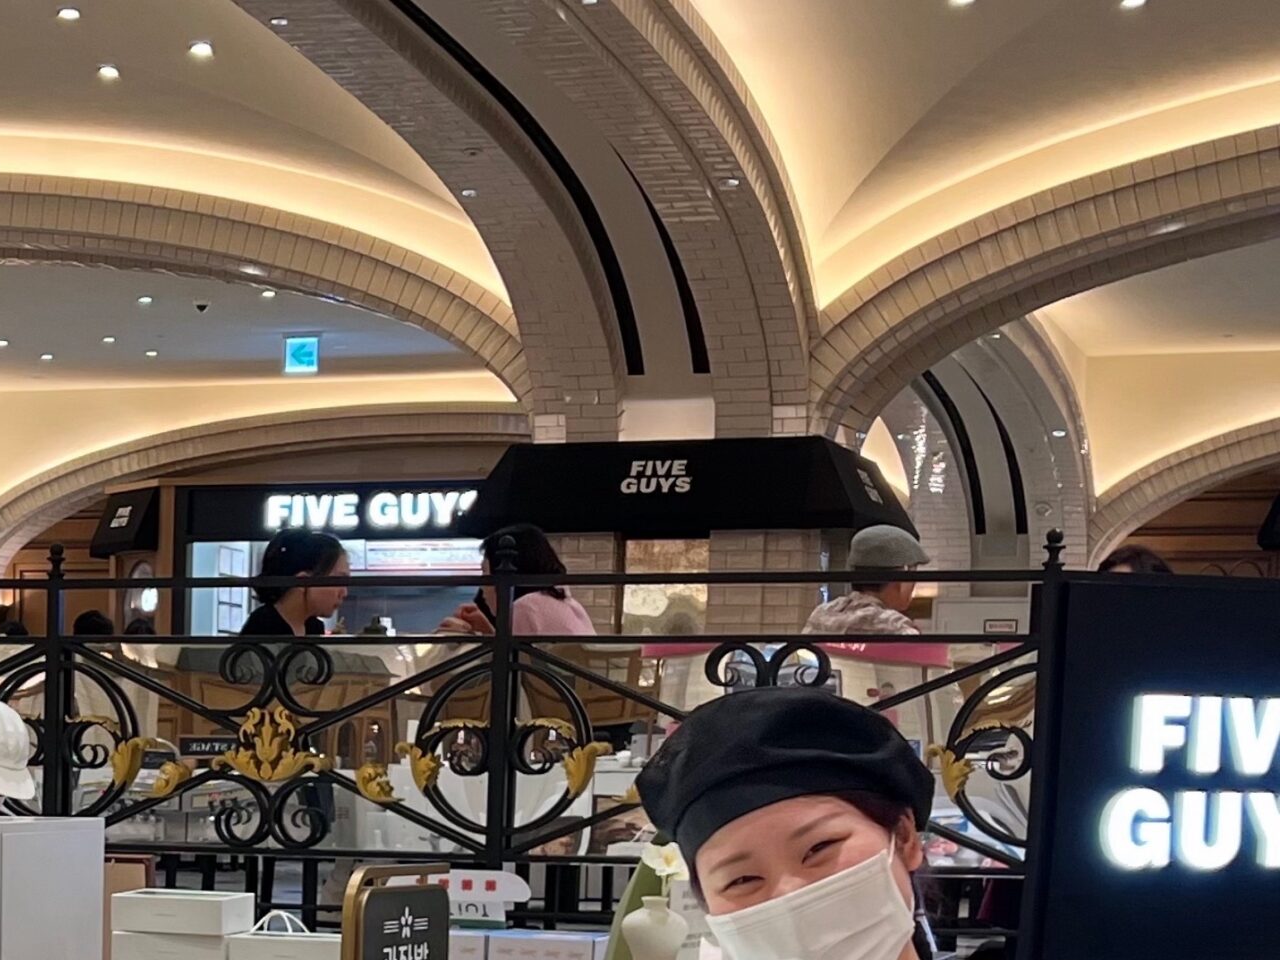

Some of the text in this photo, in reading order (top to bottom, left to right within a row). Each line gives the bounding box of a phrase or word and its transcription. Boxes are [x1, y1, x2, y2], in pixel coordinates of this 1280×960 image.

[629, 459, 688, 477] FIVE
[620, 476, 691, 494] GUYS
[266, 493, 360, 530] FIVE
[1129, 694, 1280, 775] FIV
